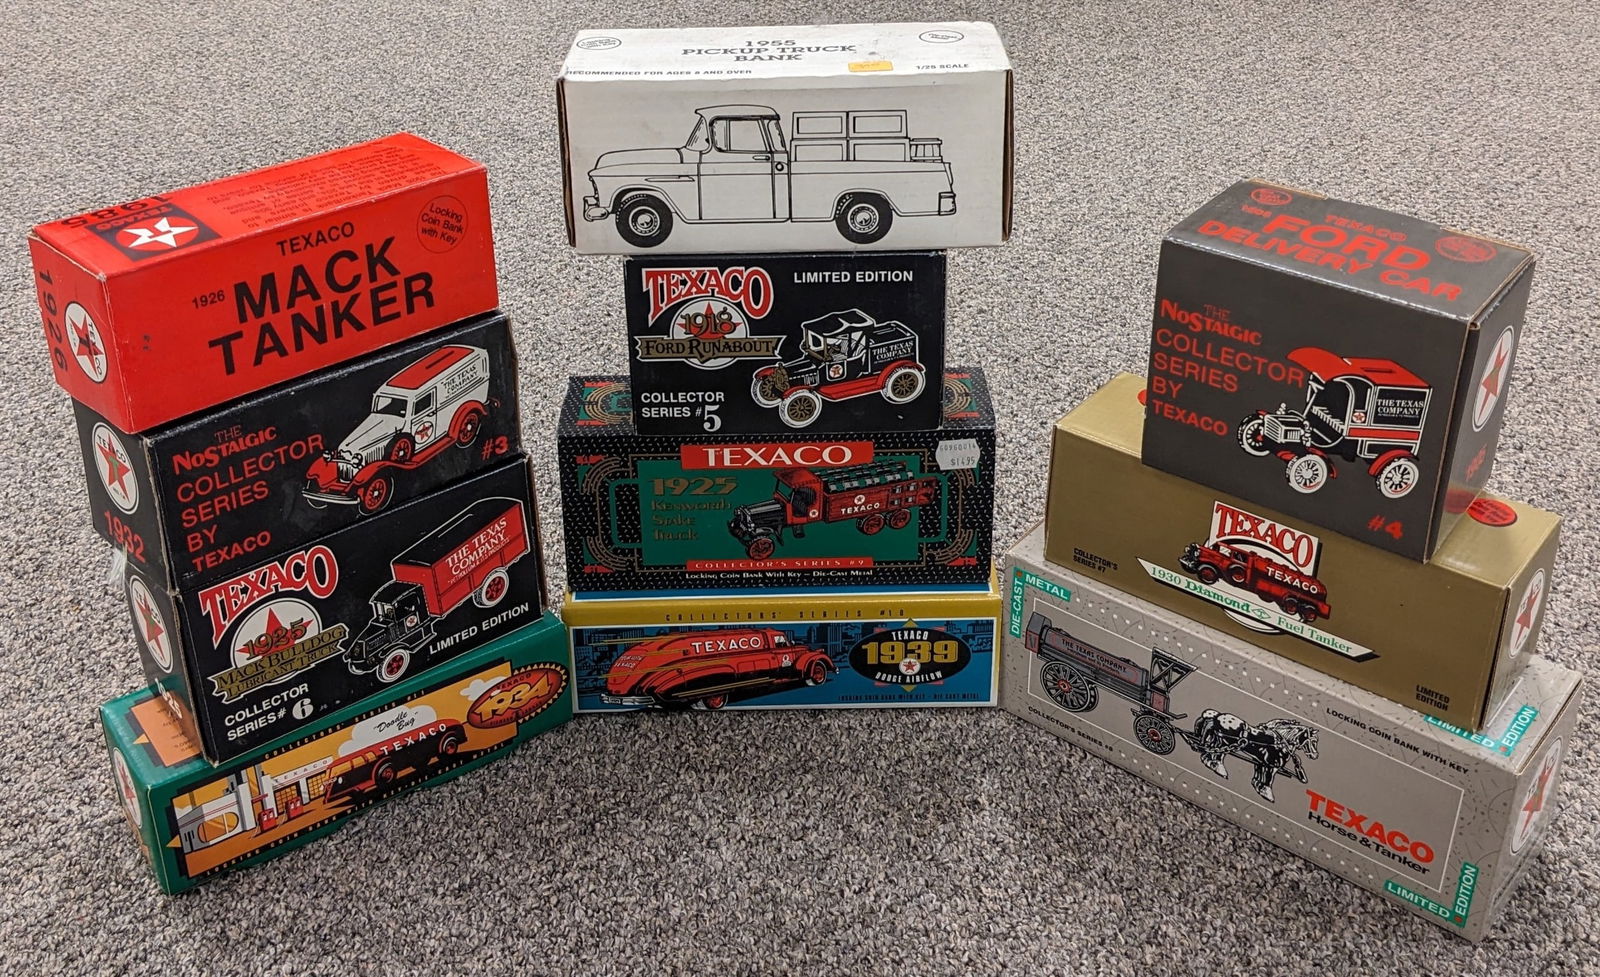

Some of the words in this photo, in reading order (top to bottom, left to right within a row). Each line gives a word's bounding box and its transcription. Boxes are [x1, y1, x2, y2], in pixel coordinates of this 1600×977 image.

[682, 47, 770, 55] PICKUP
[777, 45, 856, 54] TRUCK
[746, 39, 796, 47] 1955
[734, 54, 803, 62] BANK
[421, 212, 441, 227] Coin
[441, 219, 464, 236] Bank
[429, 202, 464, 222] Locking
[276, 222, 356, 256] TEXACO
[421, 226, 441, 240] with
[440, 231, 458, 246] Key
[1263, 214, 1430, 271] FORD
[1324, 215, 1407, 243] TEXACO
[1197, 220, 1374, 274] DELIVERY
[1379, 269, 1463, 301] CAR
[192, 289, 226, 310] 1926
[233, 236, 402, 325] MACK
[794, 271, 850, 283] LIMITED
[855, 270, 914, 282] EDITION
[642, 266, 775, 328] TEXACO
[38, 270, 68, 373] 1926
[208, 271, 435, 376] TANKER
[680, 306, 737, 336] 1918
[1203, 304, 1231, 321] THE
[645, 340, 686, 356] FORD
[688, 338, 773, 360] RUNABOUT
[872, 347, 888, 355] THE
[889, 341, 914, 351] TEXAS
[876, 347, 912, 360] COMPANY
[1156, 328, 1306, 388] COLLECTOR
[1153, 352, 1239, 392] SERIES
[641, 392, 725, 403] COLLECTOR
[1152, 376, 1183, 399] BY
[641, 407, 691, 418] SERIES
[1377, 398, 1395, 407] THE
[1395, 399, 1425, 408] TEXAS
[1377, 406, 1421, 416] COMPANY
[1151, 399, 1229, 437] TEXACO
[214, 425, 242, 443] THE
[481, 435, 510, 461] #3
[177, 433, 325, 502] COLLECTOR
[702, 445, 852, 467] TEXACO
[649, 476, 738, 496] 1925
[182, 480, 269, 528] SERIES
[840, 502, 880, 515] TEXACO
[104, 510, 146, 563] 1932
[187, 524, 218, 552] BY
[1214, 502, 1314, 568] TEXACO
[1366, 514, 1404, 540] #4
[192, 531, 272, 571] TEXACO
[445, 544, 470, 568] THE
[472, 517, 507, 548] TEXAS
[452, 529, 505, 575] COMPANY
[695, 560, 787, 569] COLLECTOR'S
[849, 559, 864, 567] #9
[1073, 547, 1119, 571] COLLECTOR'S
[1073, 554, 1096, 570] SERIES
[1025, 573, 1069, 600] METAL
[1266, 565, 1319, 595] TEXACO
[198, 545, 338, 650] TEXACO
[1011, 578, 1024, 635] DIE-CAST
[1149, 564, 1182, 586] 1930
[1184, 576, 1251, 613] Diamond
[1277, 615, 1305, 635] Fuel
[1308, 627, 1353, 654] Tanker
[243, 618, 307, 661] 1925
[429, 626, 478, 655] LIMITED
[482, 602, 530, 631] EDITION
[891, 630, 929, 642] TEXACO
[214, 658, 265, 690] MACK
[266, 624, 345, 669] BULLDOG
[691, 636, 761, 654] TEXACO
[861, 640, 959, 665] 1939
[1062, 638, 1073, 648] THE
[227, 659, 295, 697] LUBRICANT
[300, 643, 337, 667] TRUCK
[496, 672, 532, 690] TEXACO
[875, 671, 901, 683] DODGE
[906, 670, 943, 683] AIRFLOW
[224, 683, 309, 727] COLLECTOR
[472, 670, 553, 722] 1934
[1415, 693, 1449, 712] EDITION
[1416, 684, 1450, 703] LIMITED
[291, 697, 314, 720] 6
[380, 723, 447, 756] TEXACO
[1028, 706, 1076, 734] COLLECTOR'S
[1077, 728, 1103, 747] SERIES
[1502, 707, 1536, 748] EDITION
[1326, 707, 1367, 731] LOCKING
[1368, 726, 1392, 743] COIN
[1393, 737, 1420, 754] BANK
[1421, 749, 1448, 766] WITH
[1448, 759, 1469, 775] KEY
[1306, 789, 1435, 865] TEXACO
[1308, 811, 1358, 841] Horse
[1372, 841, 1430, 875] Tanker
[1387, 881, 1450, 919] LIMITED
[1454, 864, 1478, 916] EDITION
